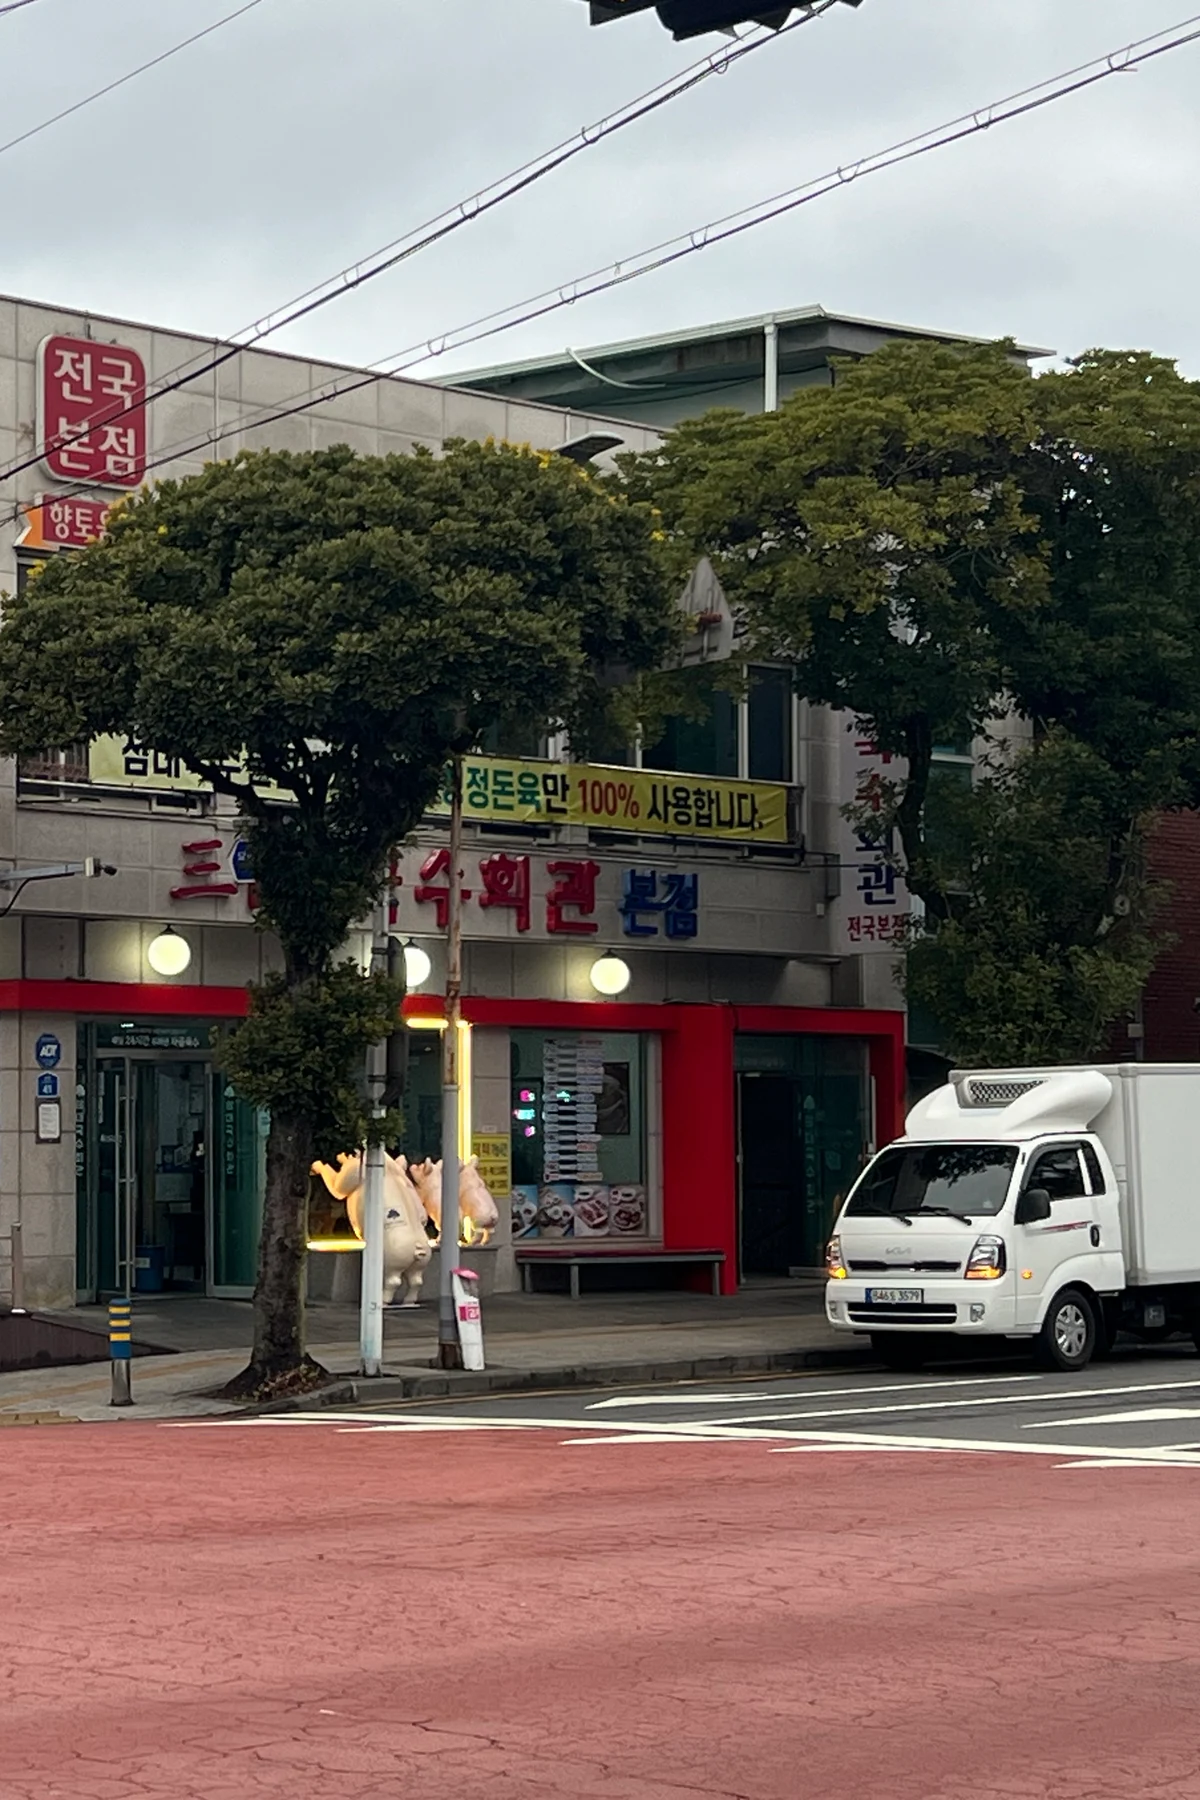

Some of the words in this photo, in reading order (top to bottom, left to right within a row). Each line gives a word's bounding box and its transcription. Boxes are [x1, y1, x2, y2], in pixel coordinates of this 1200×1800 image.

[53, 348, 138, 411] 전국
[53, 416, 137, 480] 본점
[444, 766, 570, 815] 정돈육만
[577, 778, 640, 819] 100%
[647, 783, 764, 831] 사용합니다.
